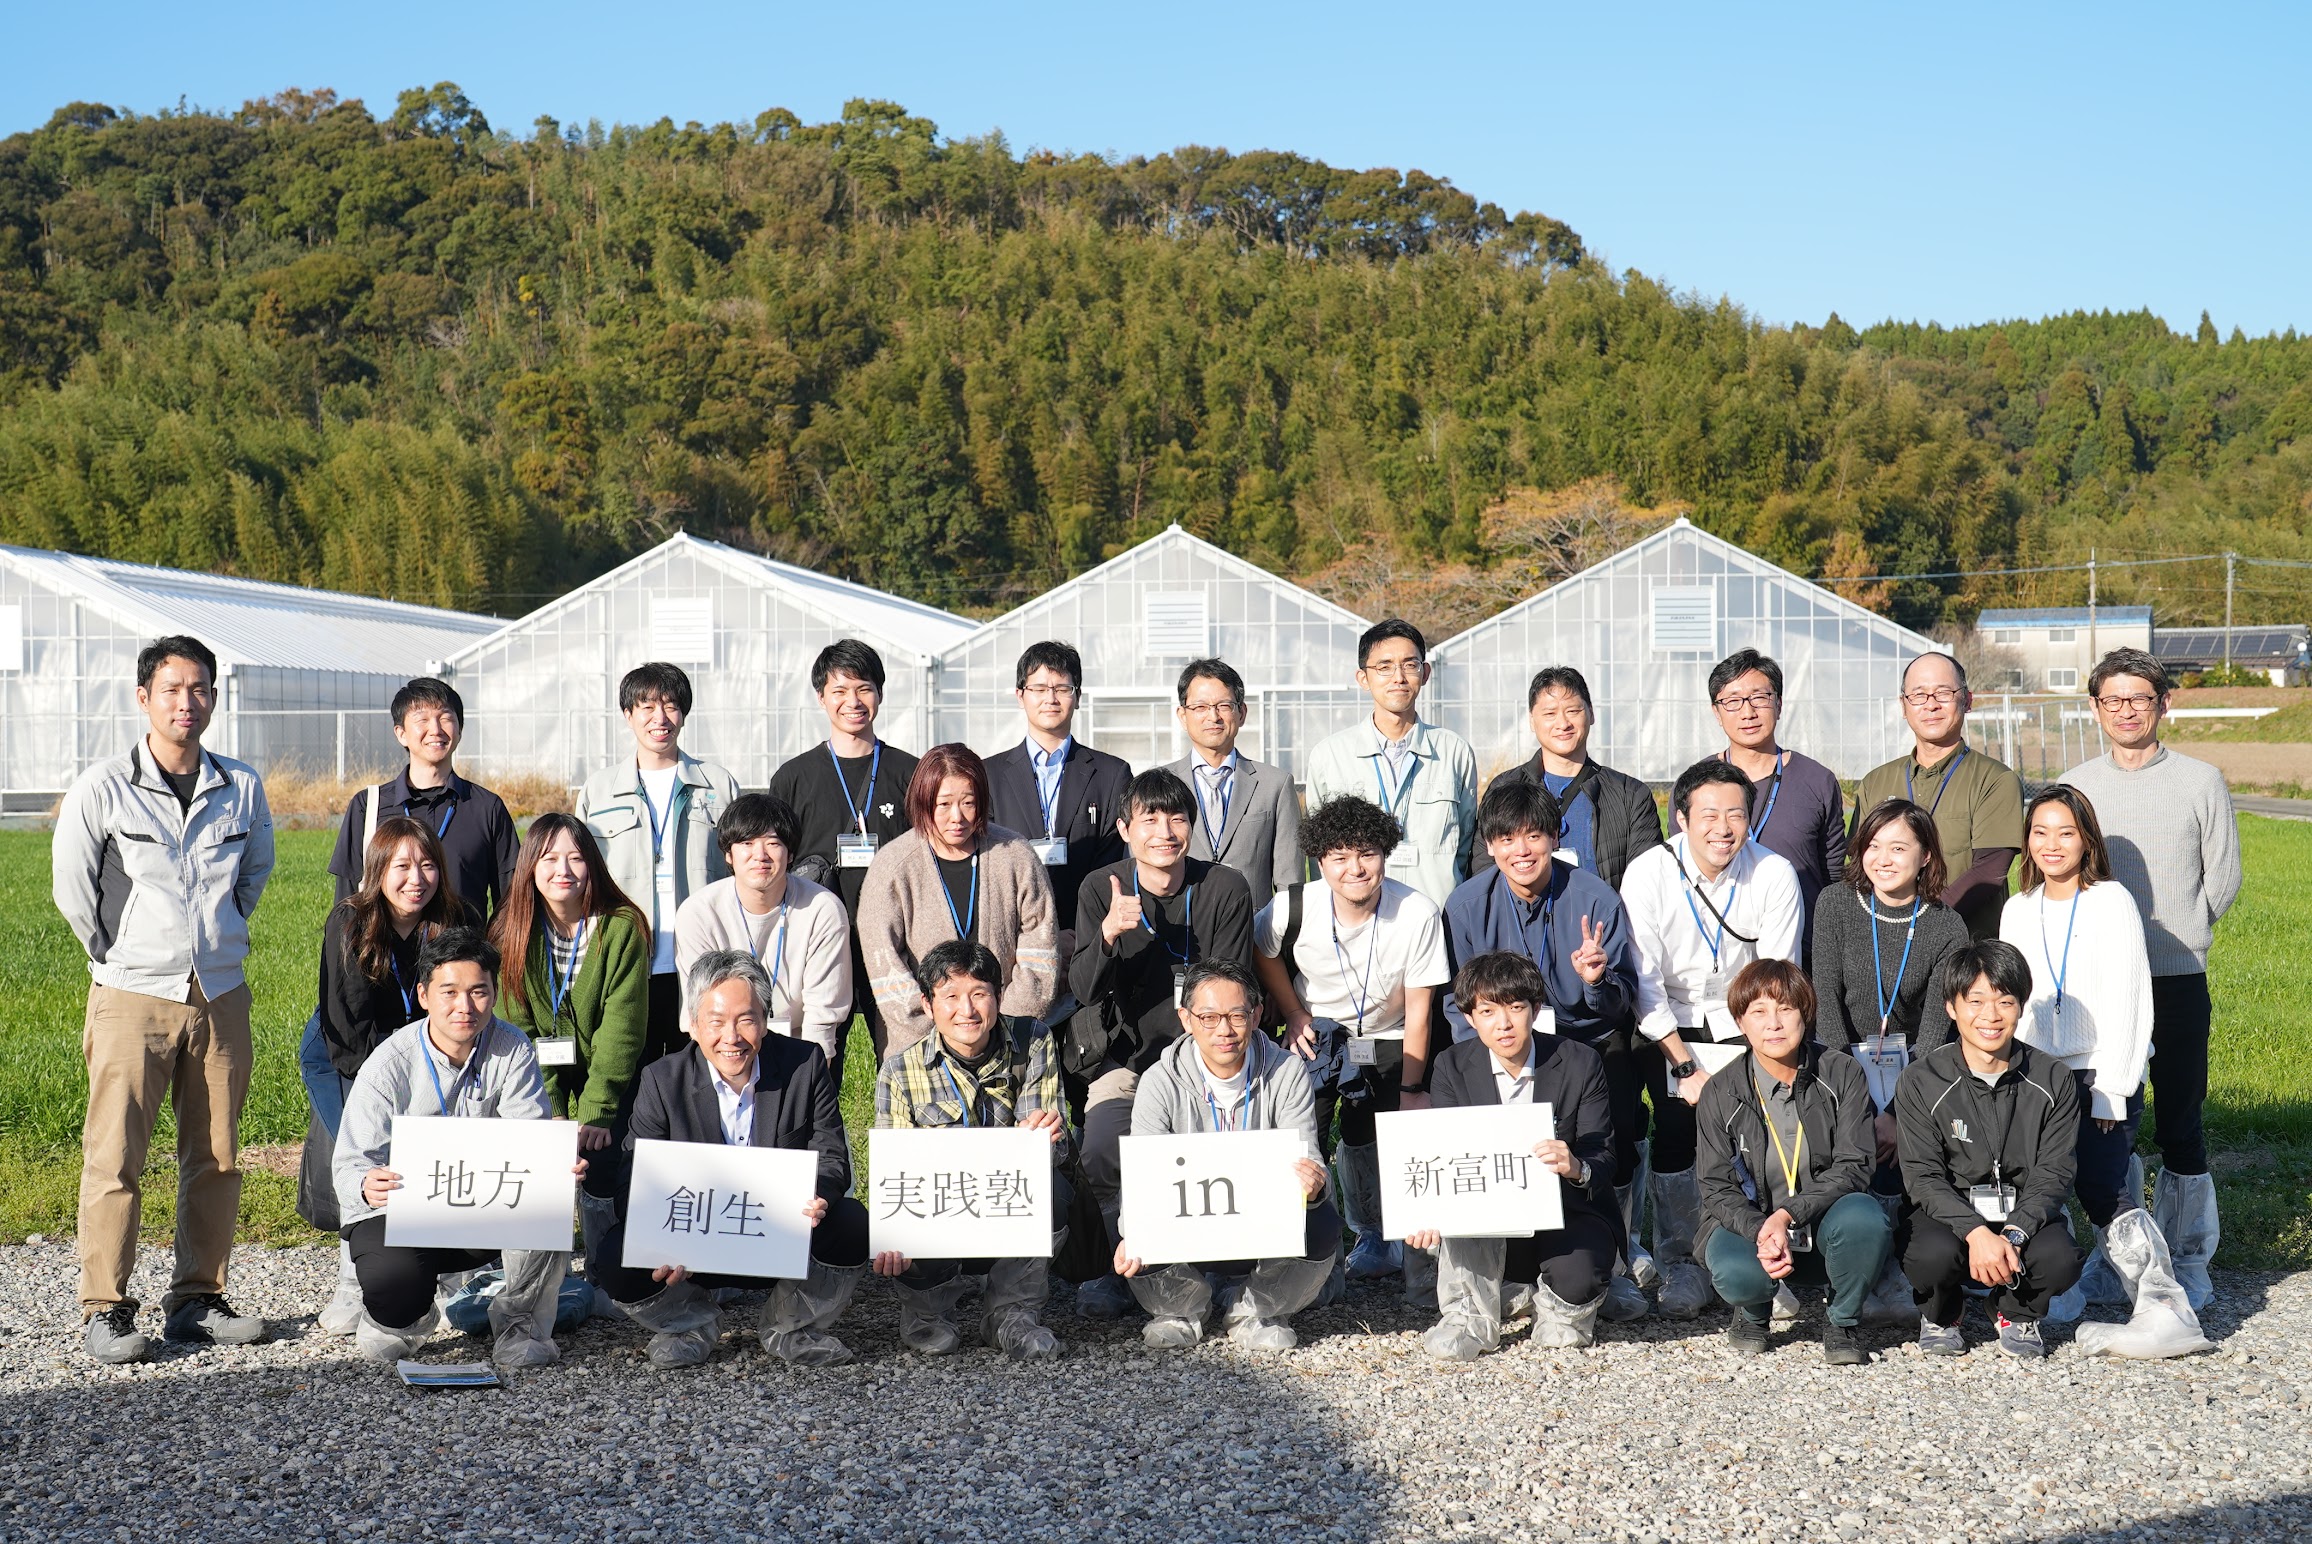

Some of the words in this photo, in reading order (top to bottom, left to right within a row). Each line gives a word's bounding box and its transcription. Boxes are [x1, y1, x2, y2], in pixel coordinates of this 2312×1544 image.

[427, 1160, 530, 1209] 地方
[879, 1169, 1034, 1221] 実践塾
[1172, 1156, 1240, 1218] in
[1403, 1152, 1533, 1198] 新富町
[662, 1185, 766, 1237] 創生
